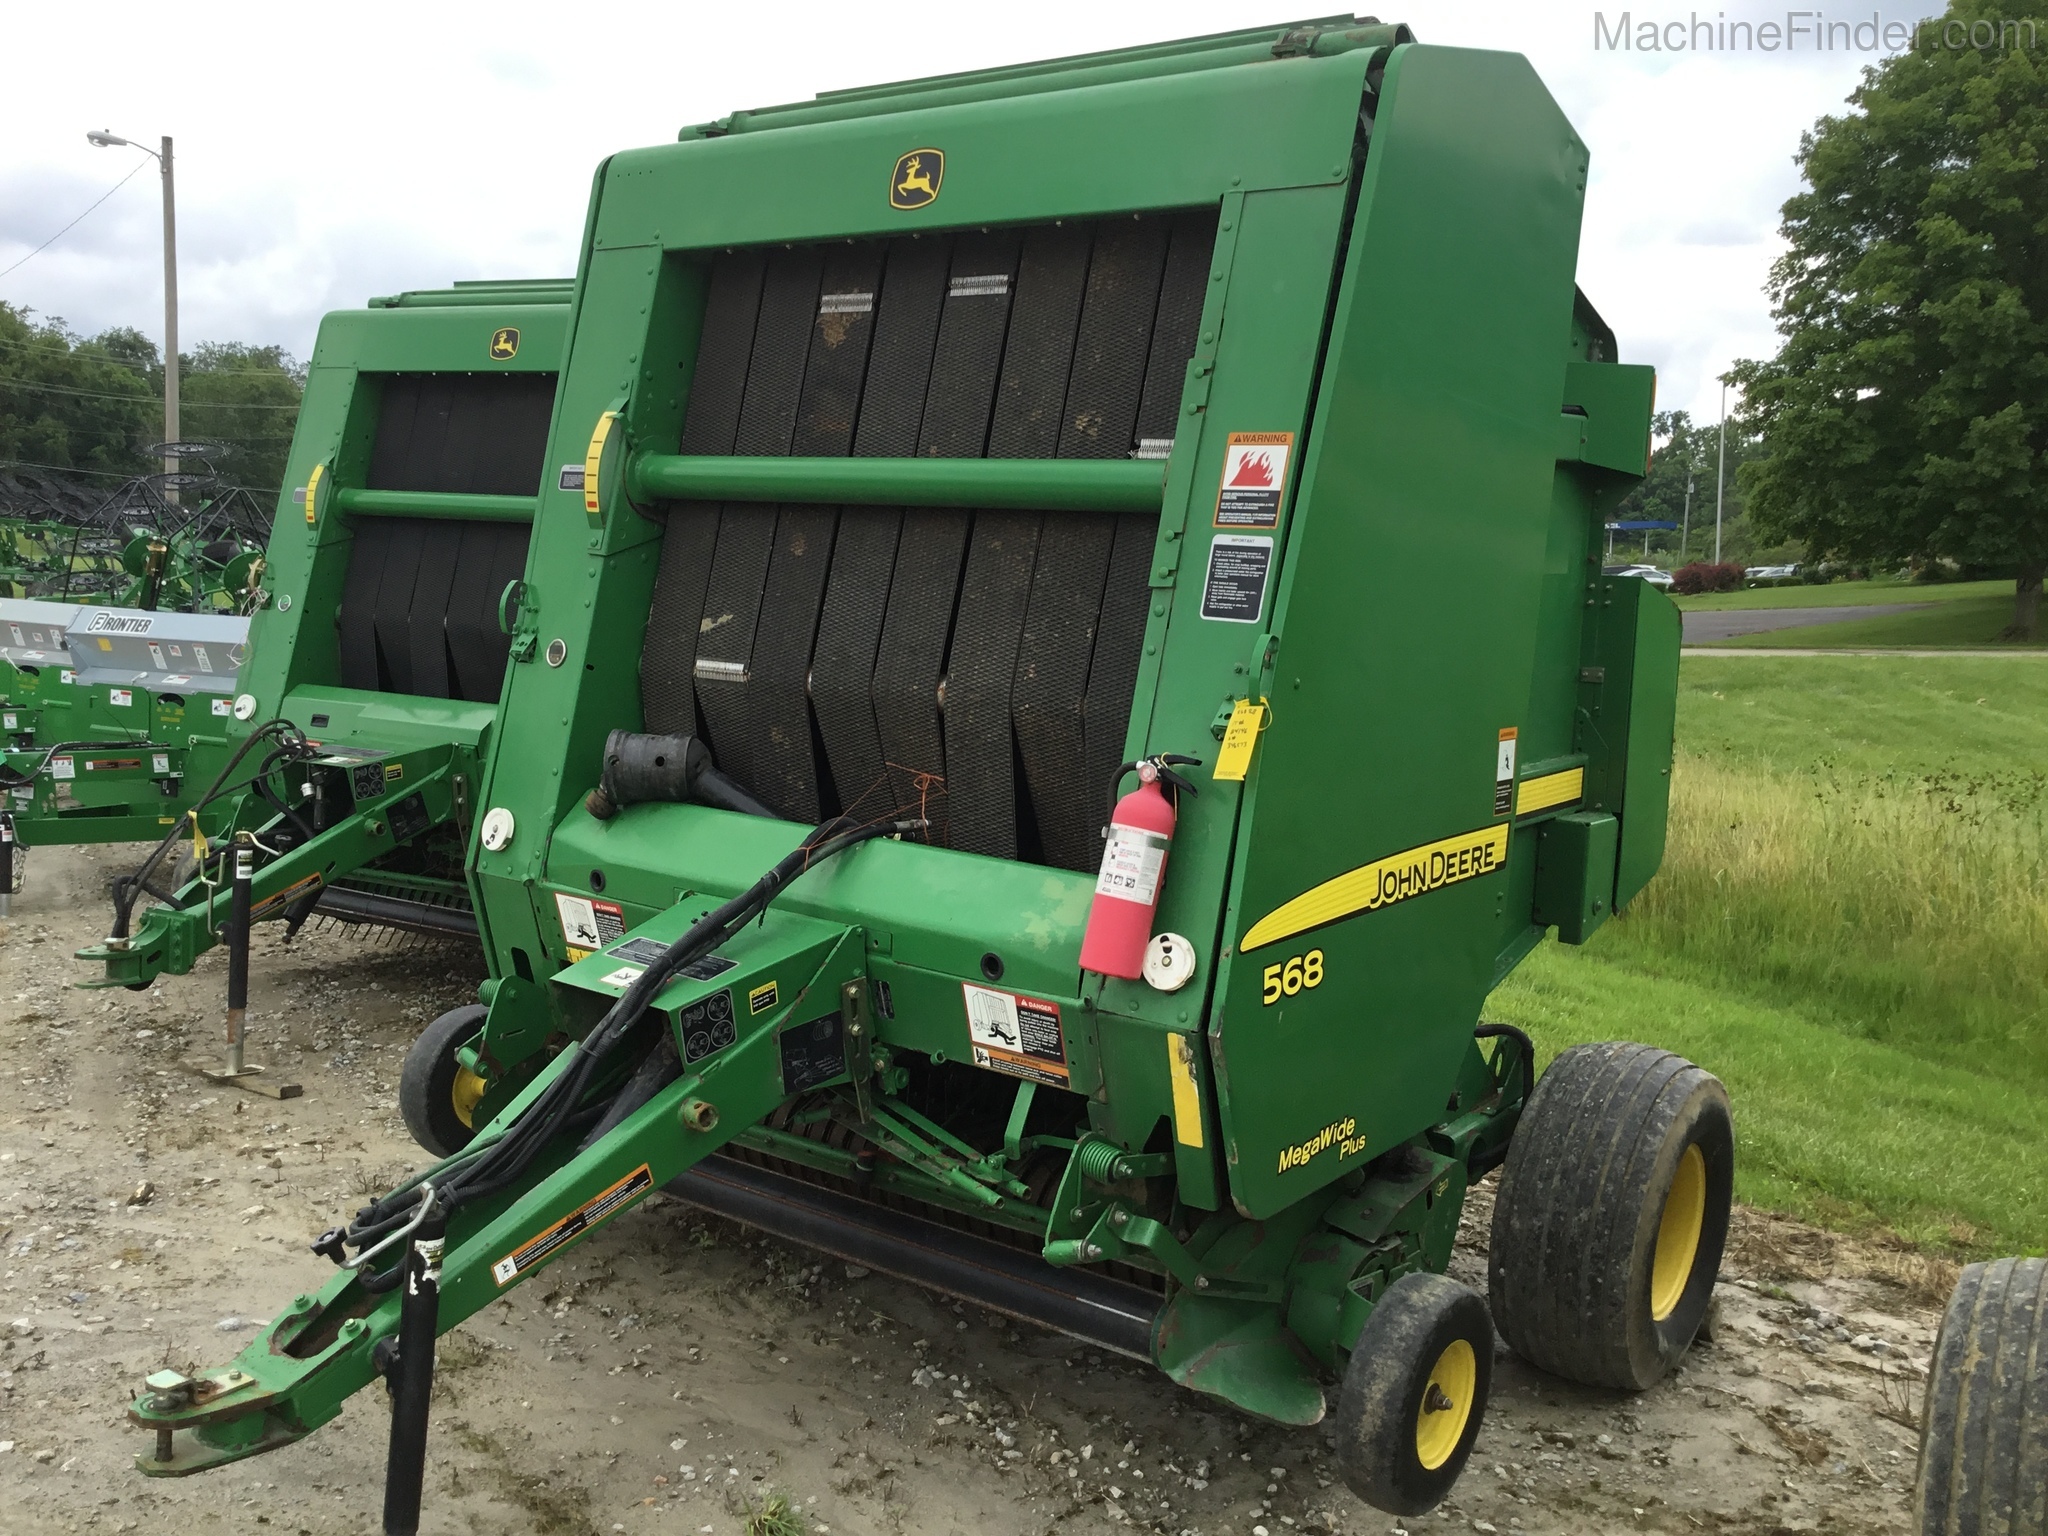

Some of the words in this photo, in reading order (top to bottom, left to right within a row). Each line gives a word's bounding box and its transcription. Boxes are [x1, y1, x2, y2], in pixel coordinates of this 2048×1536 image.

[1242, 434, 1288, 443] WARNING
[87, 612, 153, 634] FRONTIER
[1369, 861, 1427, 902] JOHN
[1430, 841, 1496, 883] DEERE
[1263, 949, 1324, 1006] 568
[1028, 1001, 1053, 1013] DANGER
[1015, 1057, 1042, 1069] WARNING
[1277, 1116, 1356, 1175] MegaWide
[1339, 1134, 1367, 1162] Plus
